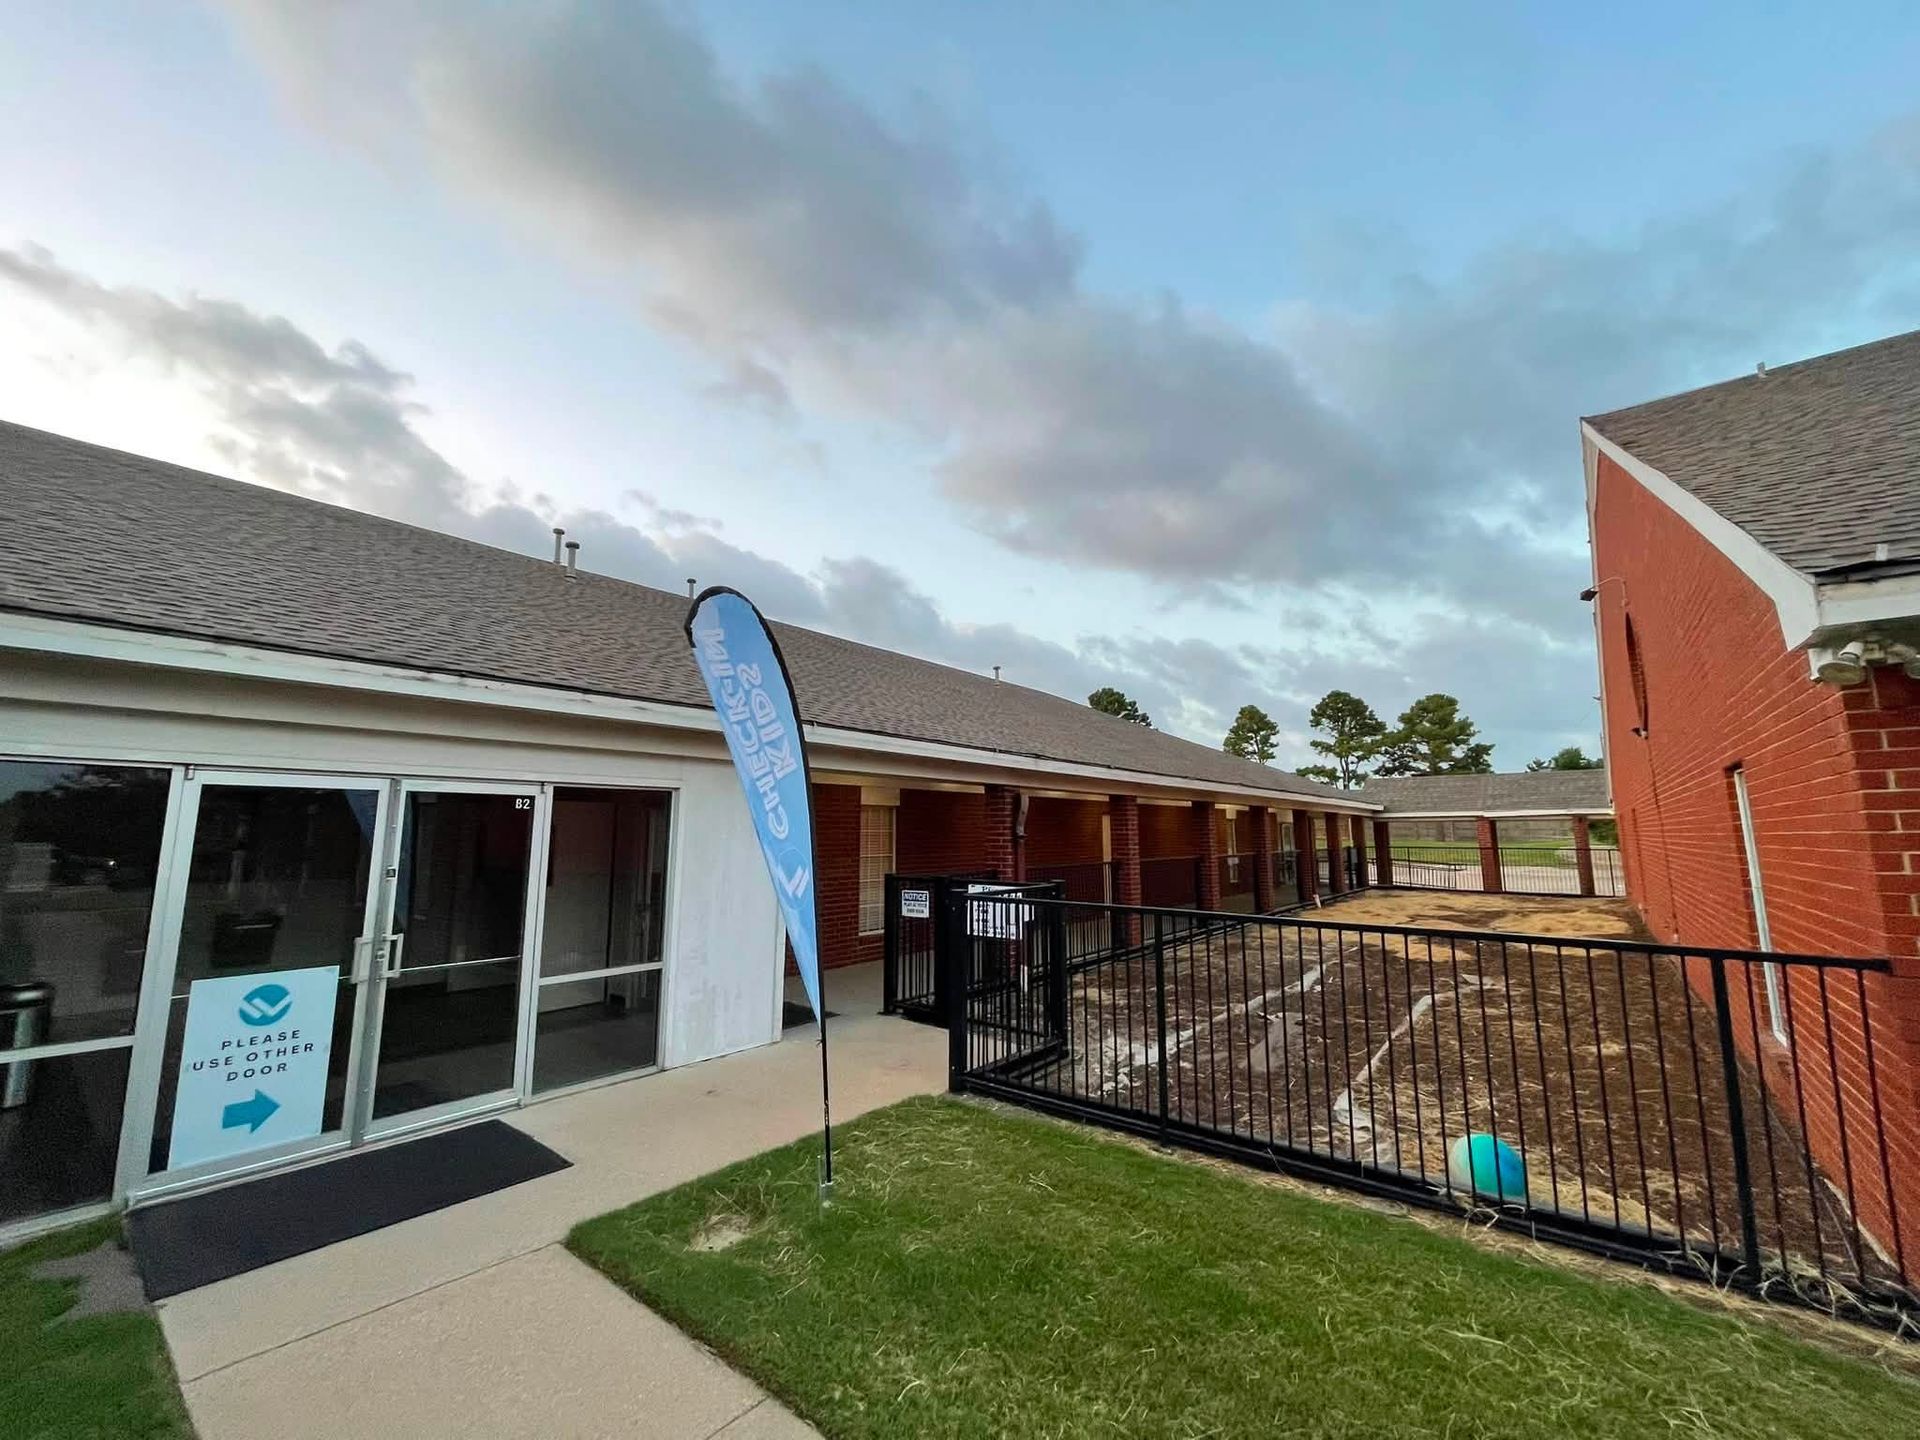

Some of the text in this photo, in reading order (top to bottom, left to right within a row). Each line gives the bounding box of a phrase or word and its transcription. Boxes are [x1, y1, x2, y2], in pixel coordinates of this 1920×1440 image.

[515, 798, 530, 809] B2
[904, 892, 927, 901] NOTICE
[221, 1030, 301, 1050] PLEASE
[193, 1043, 315, 1071] USE OTHER
[226, 1063, 288, 1082] DOOR
